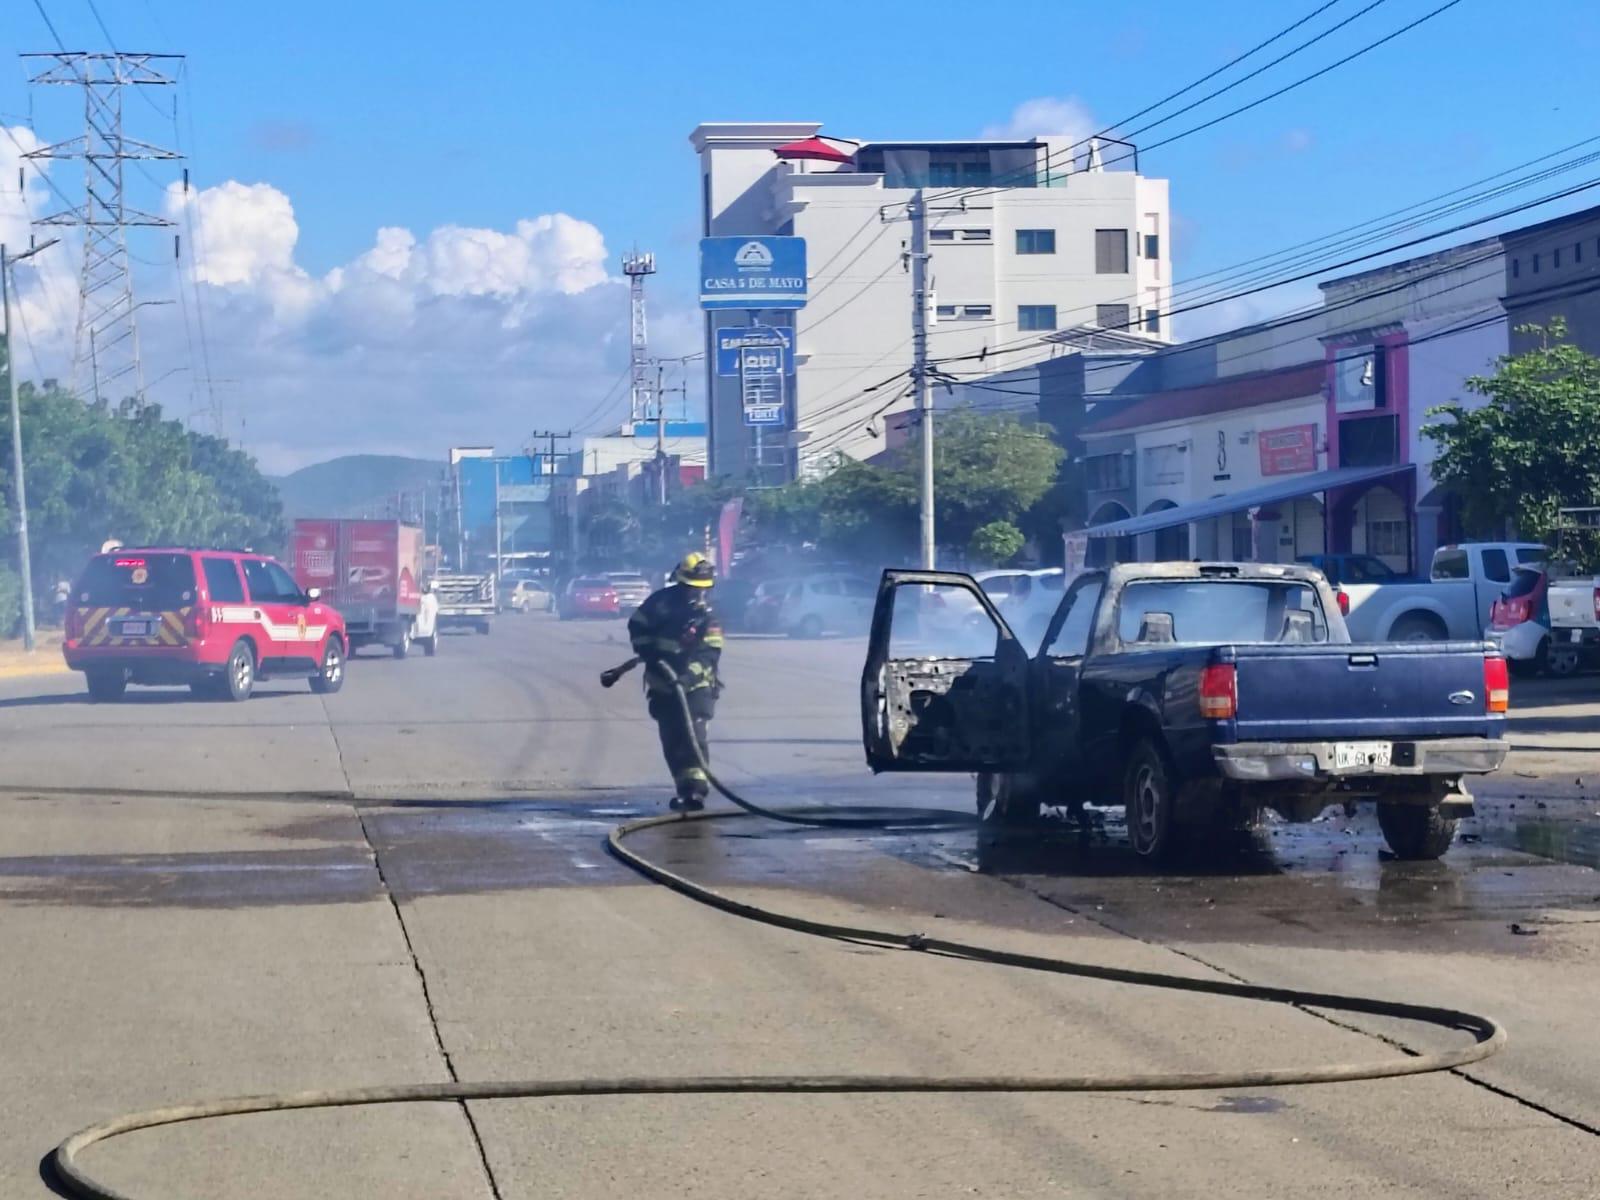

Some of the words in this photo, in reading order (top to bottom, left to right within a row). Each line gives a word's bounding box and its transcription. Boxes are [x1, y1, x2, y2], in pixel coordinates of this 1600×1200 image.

[704, 278, 737, 289] CASA
[738, 279, 746, 288] 5
[749, 278, 766, 288] DE
[769, 278, 804, 288] MAYO
